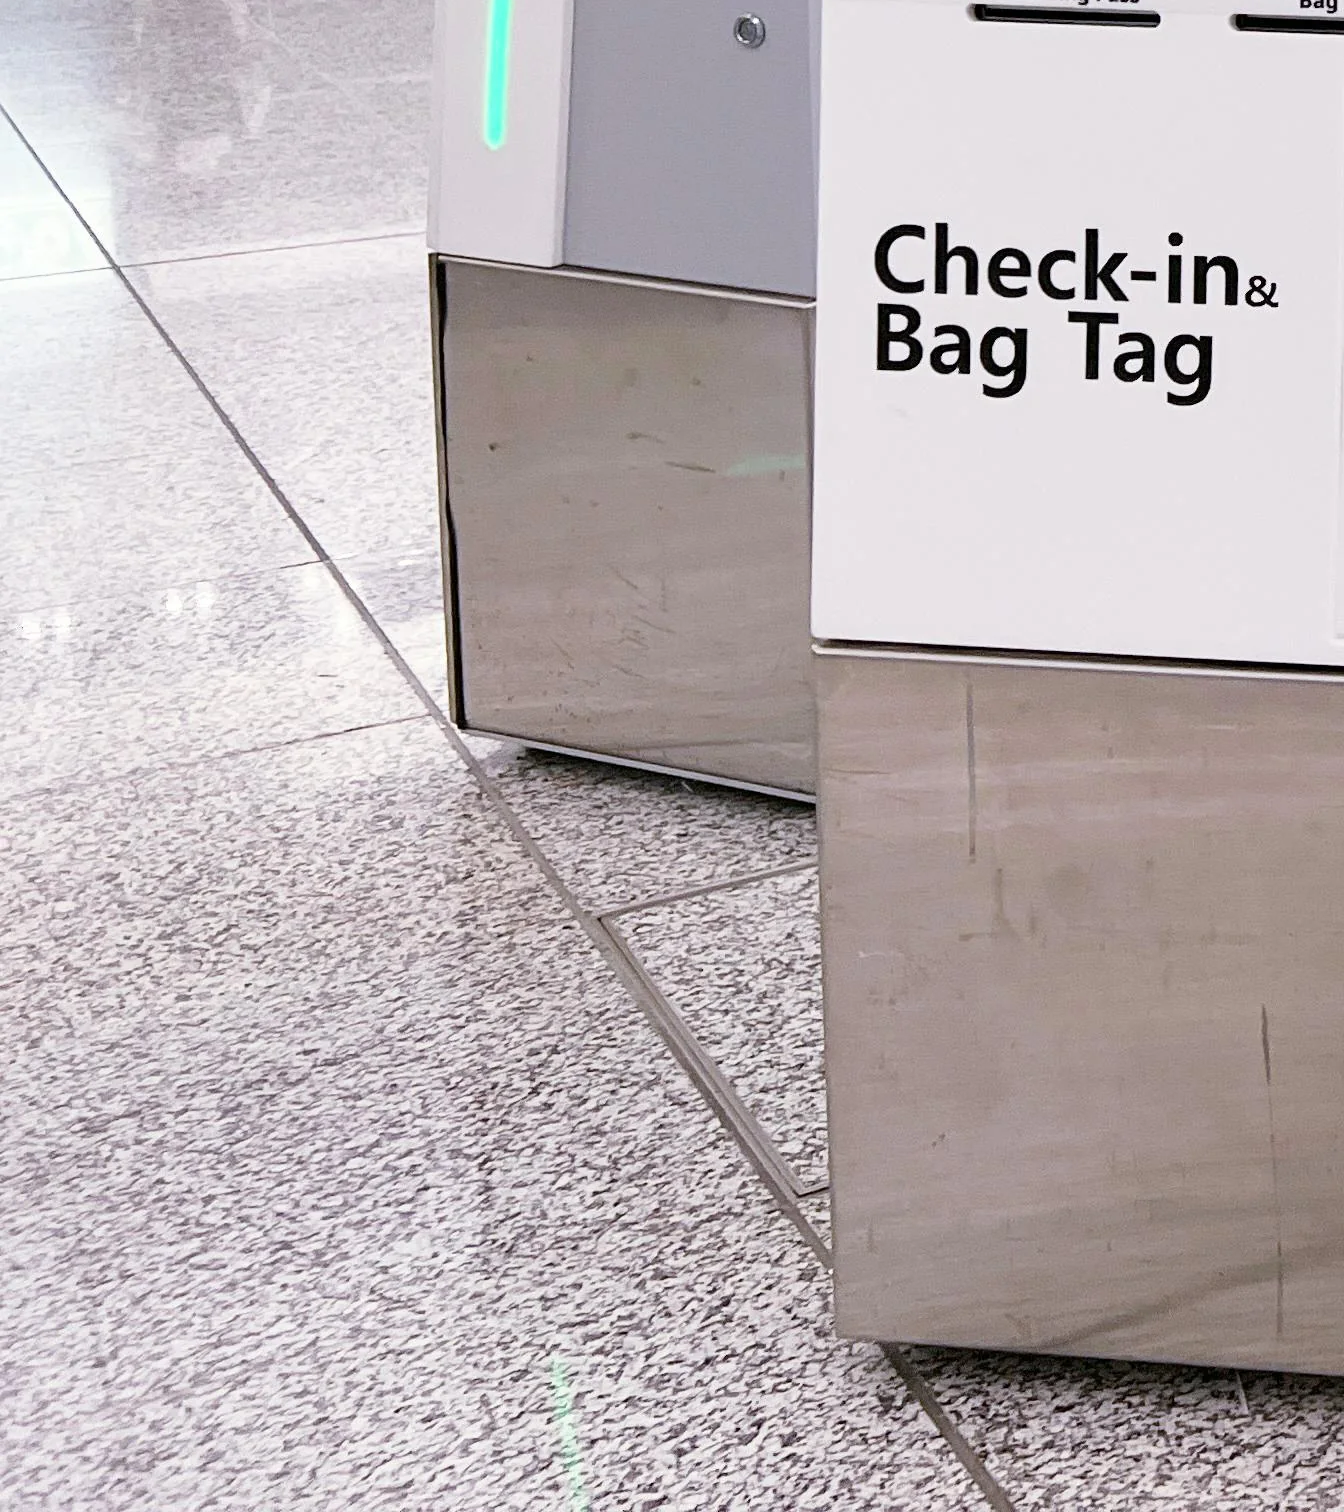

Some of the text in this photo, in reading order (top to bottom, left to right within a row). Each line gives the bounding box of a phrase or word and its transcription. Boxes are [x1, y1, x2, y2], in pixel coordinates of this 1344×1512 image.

[873, 222, 1280, 308] Check-in &
[875, 302, 1214, 406] Bag Tag
